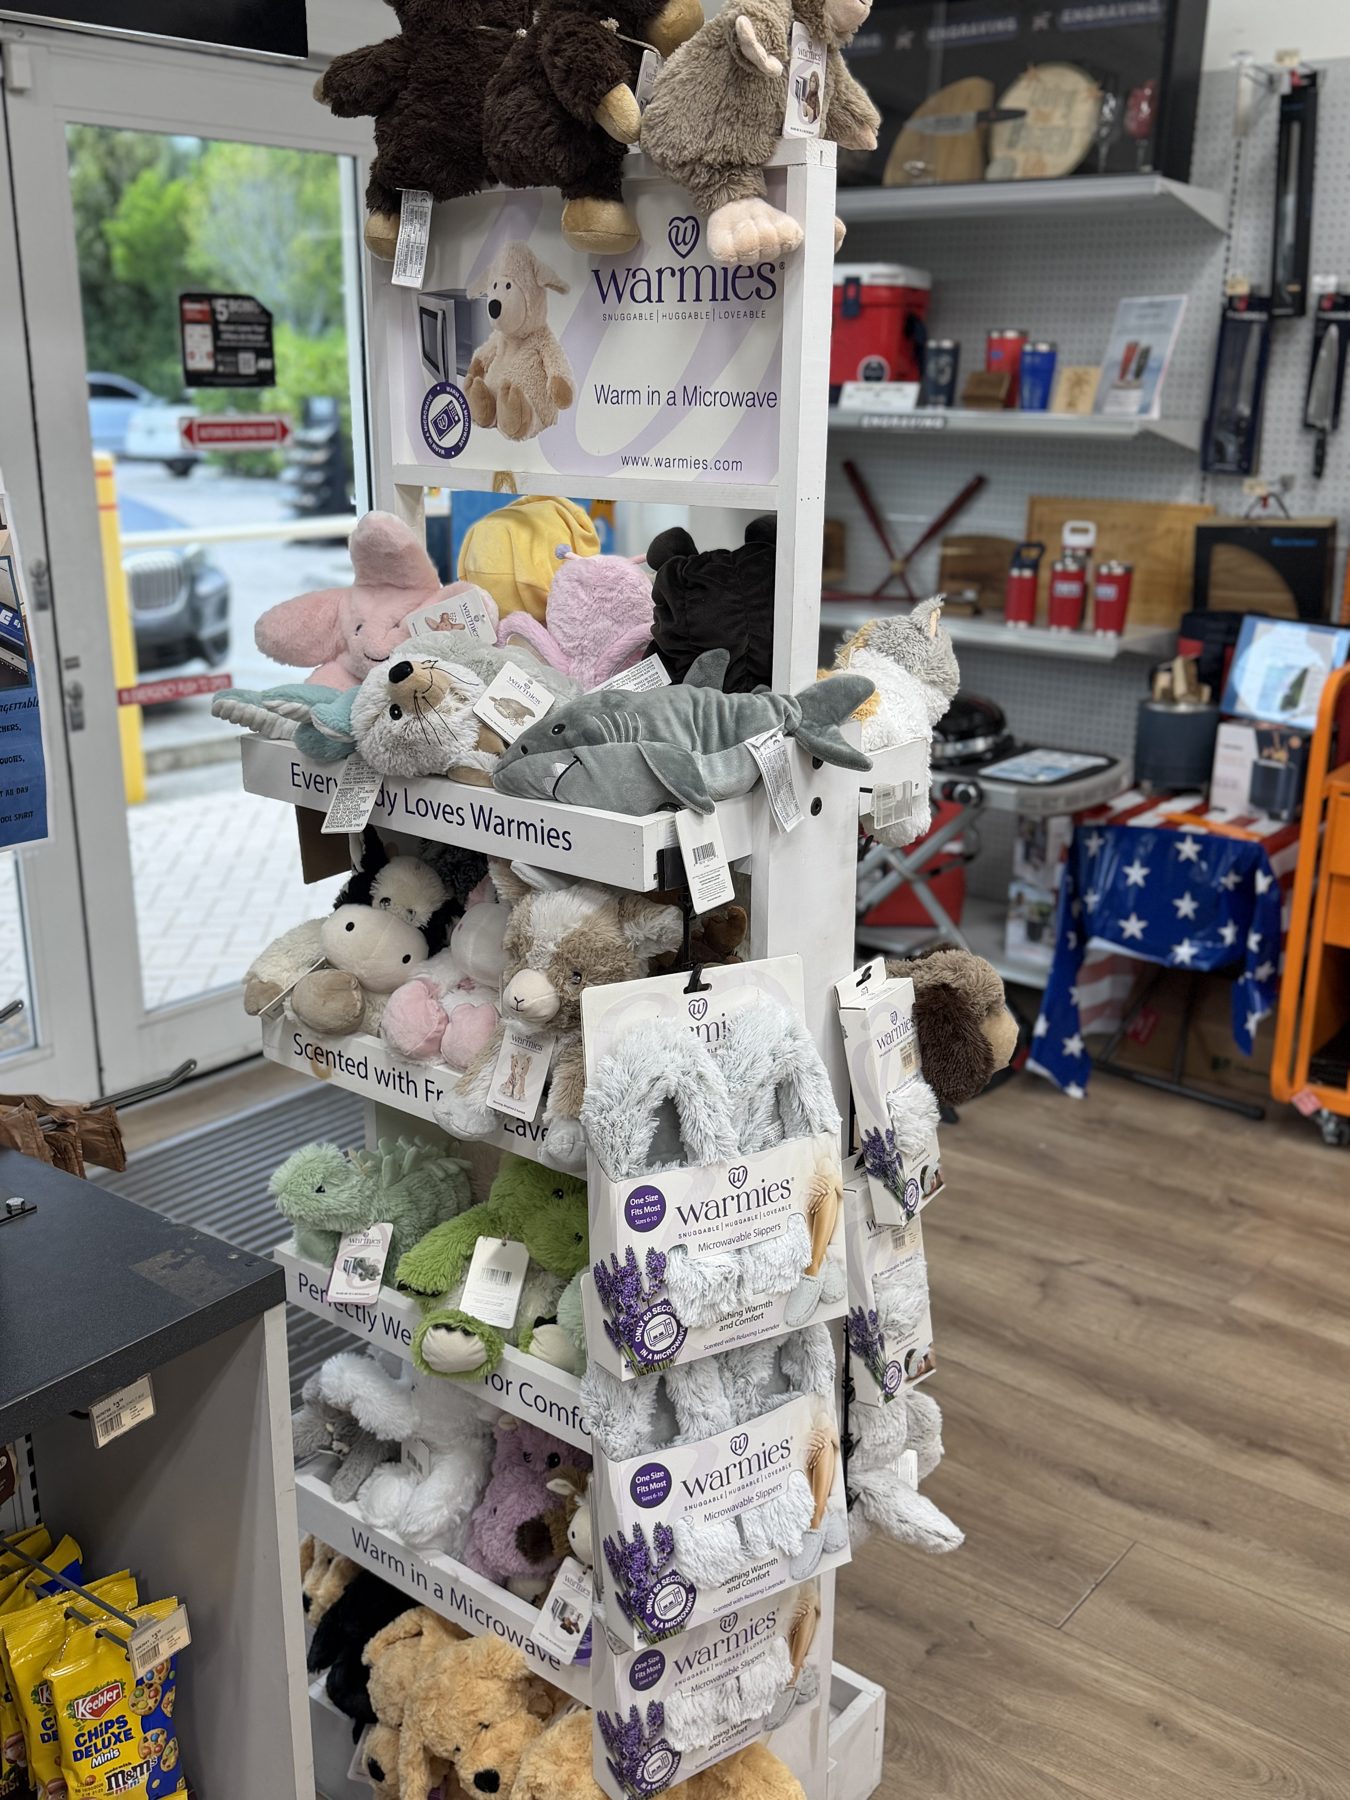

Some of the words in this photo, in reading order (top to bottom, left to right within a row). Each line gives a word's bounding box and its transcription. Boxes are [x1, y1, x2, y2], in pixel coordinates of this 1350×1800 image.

[602, 312, 654, 322] SNUGGABLE
[661, 311, 710, 320] HUGGABLE
[718, 310, 766, 320] LOVEABLE
[594, 384, 641, 405] Warm
[647, 385, 661, 406] in
[666, 390, 677, 407] a
[682, 385, 778, 408] Microwave
[621, 455, 743, 472] www.warmies.com
[404, 788, 466, 826] Loves
[470, 802, 573, 851] Warmies
[293, 1033, 368, 1081] Scented
[374, 1066, 418, 1099] with
[630, 1198, 644, 1206] One
[645, 1194, 659, 1202] Size
[630, 1208, 643, 1216] Fits
[644, 1204, 661, 1213] Most
[678, 1225, 720, 1240] SNUGGABLE
[725, 1214, 758, 1228] HUGGABLE
[763, 1204, 792, 1218] LOVEABLE
[698, 1231, 752, 1252] Microwavable
[754, 1223, 781, 1238] Slippers
[744, 1300, 773, 1314] Warmth
[635, 1320, 645, 1343] ONLY
[643, 1312, 652, 1321] 60
[652, 1305, 673, 1315] SECO
[718, 1322, 734, 1332] and
[734, 1312, 764, 1328] Comfort
[703, 1340, 724, 1351] Scented
[724, 1337, 736, 1345] with
[758, 1323, 780, 1334] Lavender
[640, 1348, 648, 1357] IN
[636, 1476, 650, 1484] One
[650, 1471, 664, 1480] Size
[636, 1485, 649, 1494] Fits
[649, 1480, 667, 1491] Most
[684, 1494, 724, 1512] SNUGGABLE
[728, 1478, 760, 1496] HUGGABLE
[764, 1462, 792, 1480] LOVEABLE
[703, 1496, 754, 1522] Microwavable
[755, 1482, 783, 1501] Slippers
[750, 1557, 778, 1574] Warmth
[726, 1584, 741, 1594] and
[742, 1570, 770, 1587] Comfort
[352, 1527, 405, 1577] Warm
[411, 1563, 428, 1590] in
[434, 1583, 444, 1600] a
[450, 1588, 561, 1672] Microwave
[646, 1592, 655, 1614] ONLY
[653, 1584, 662, 1593] 60
[665, 1592, 694, 1628] MICROWAVE
[634, 1661, 647, 1671] One
[648, 1655, 660, 1666] Size
[635, 1671, 646, 1680] Fits
[646, 1664, 662, 1675] Most
[690, 1666, 739, 1693] Microwavable
[740, 1650, 766, 1670] Slippers
[78, 1687, 120, 1718] Keebler
[72, 1728, 134, 1762] DELUXE
[708, 1741, 721, 1751] and
[721, 1725, 748, 1743] Comfort
[91, 1748, 120, 1769] Minis
